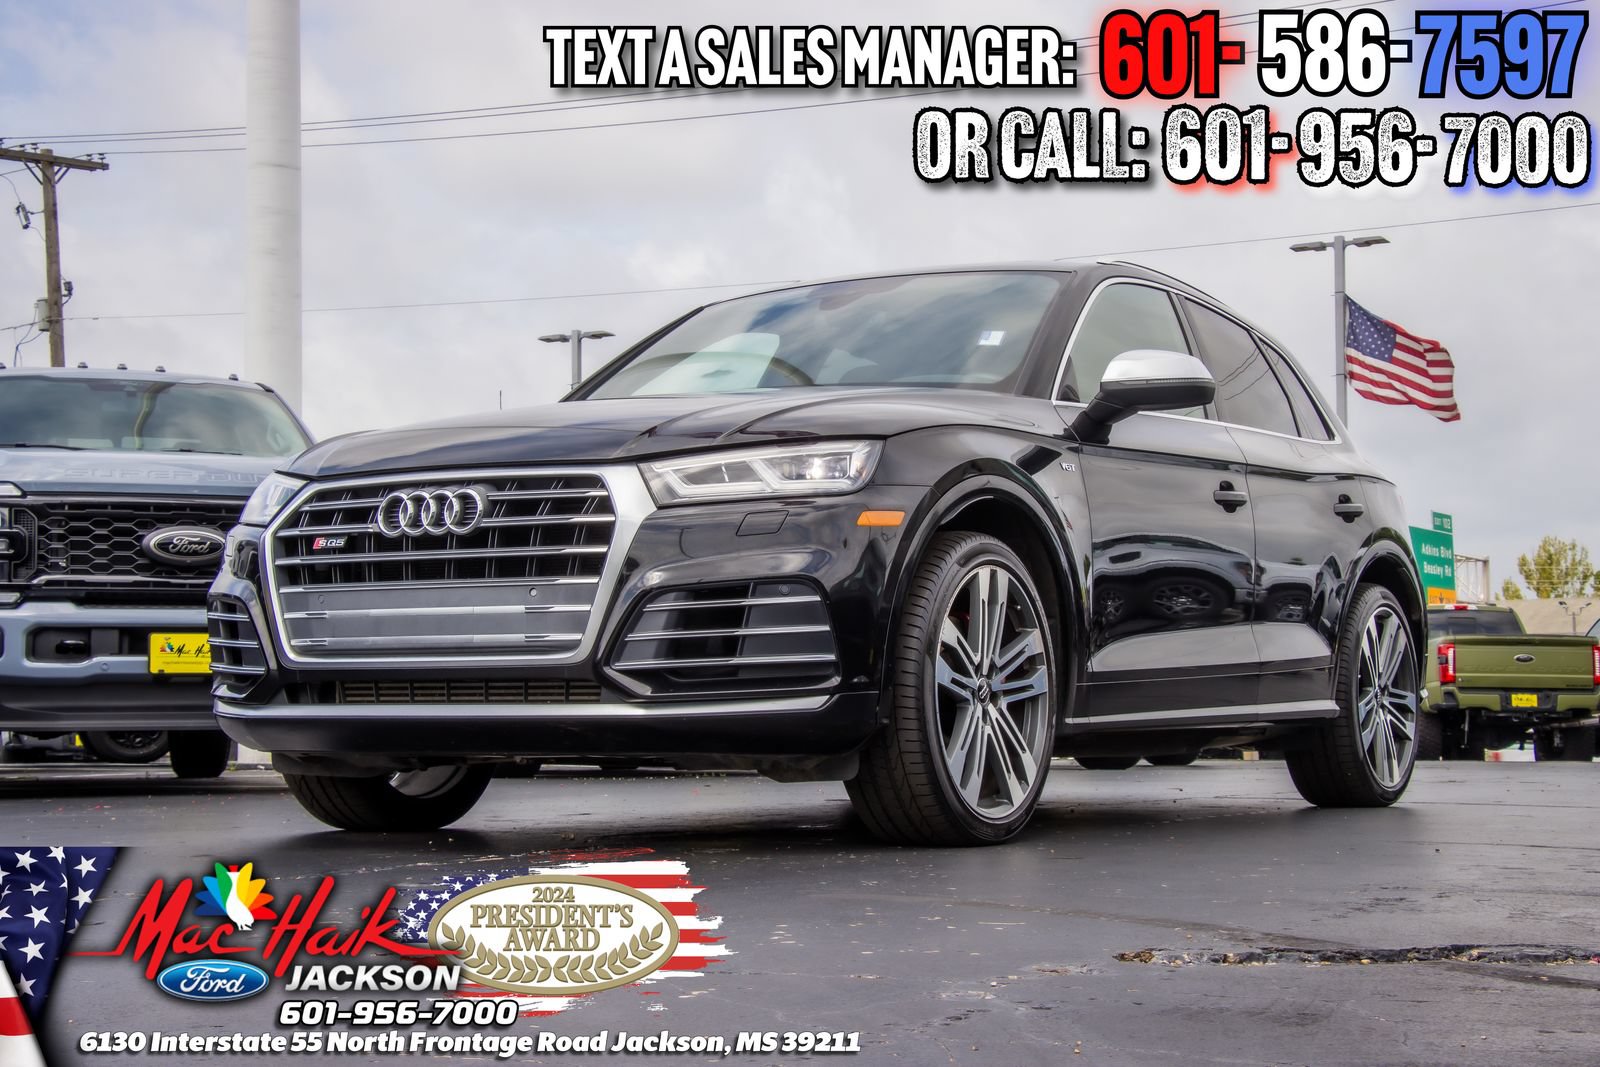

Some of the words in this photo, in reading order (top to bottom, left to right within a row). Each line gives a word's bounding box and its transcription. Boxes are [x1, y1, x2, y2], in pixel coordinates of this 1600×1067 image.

[64, 467, 194, 482] SUPER
[168, 536, 210, 553] Ford
[1421, 542, 1440, 557] Adkins
[1440, 546, 1452, 559] Blvd
[1423, 561, 1443, 579] Beasley
